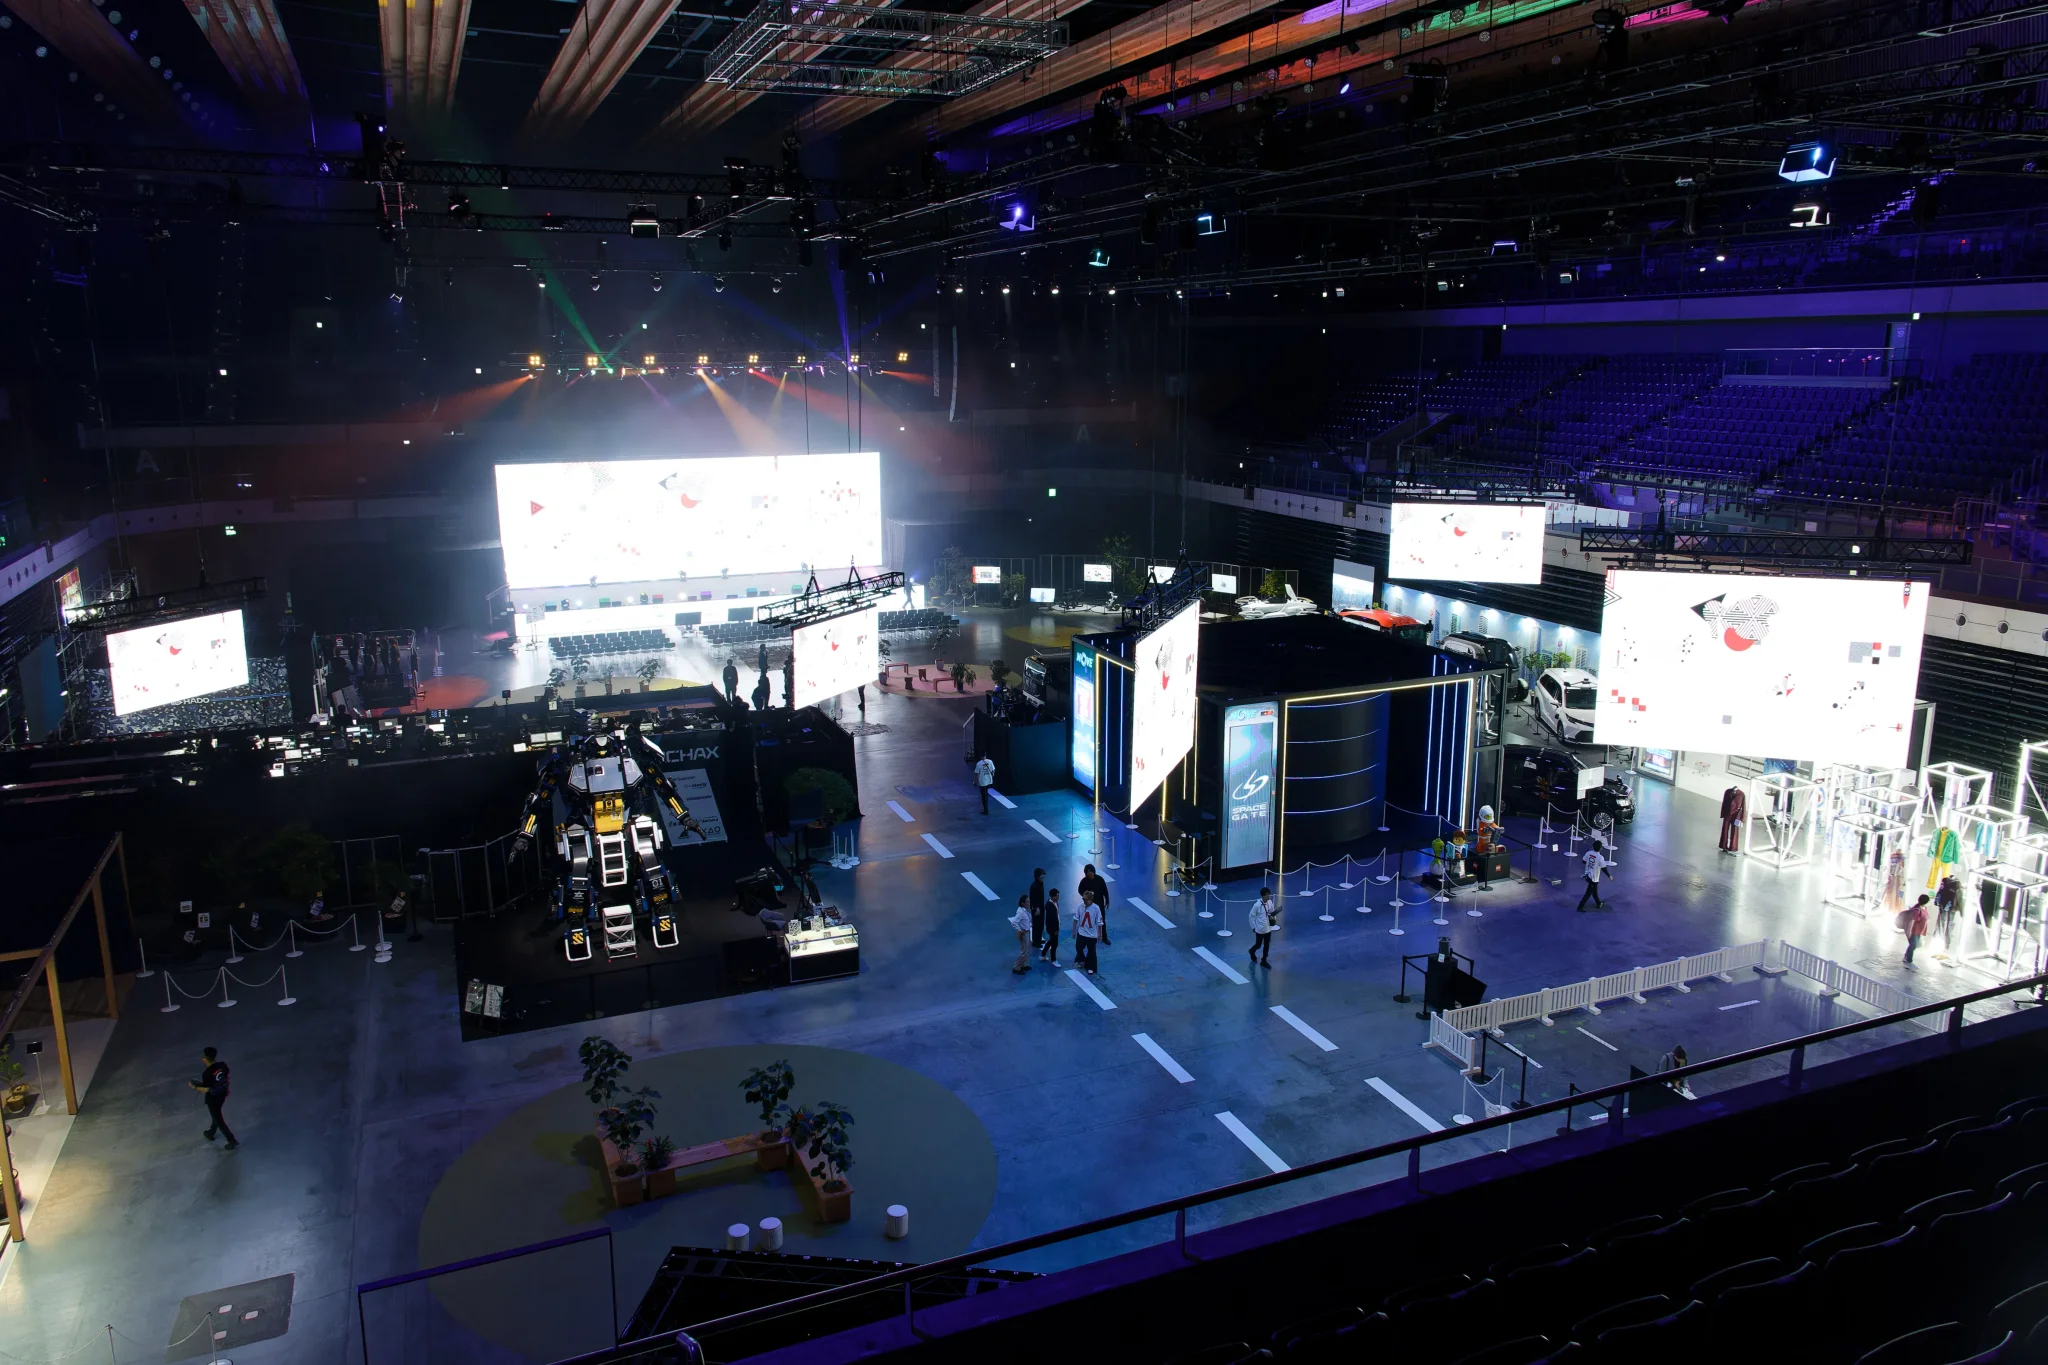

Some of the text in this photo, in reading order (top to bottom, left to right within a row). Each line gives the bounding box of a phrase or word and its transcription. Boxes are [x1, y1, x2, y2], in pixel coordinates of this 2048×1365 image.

[183, 697, 210, 705] HADO
[1232, 803, 1267, 814] SPACE
[1232, 811, 1267, 821] GATE
[652, 878, 664, 889] 01
